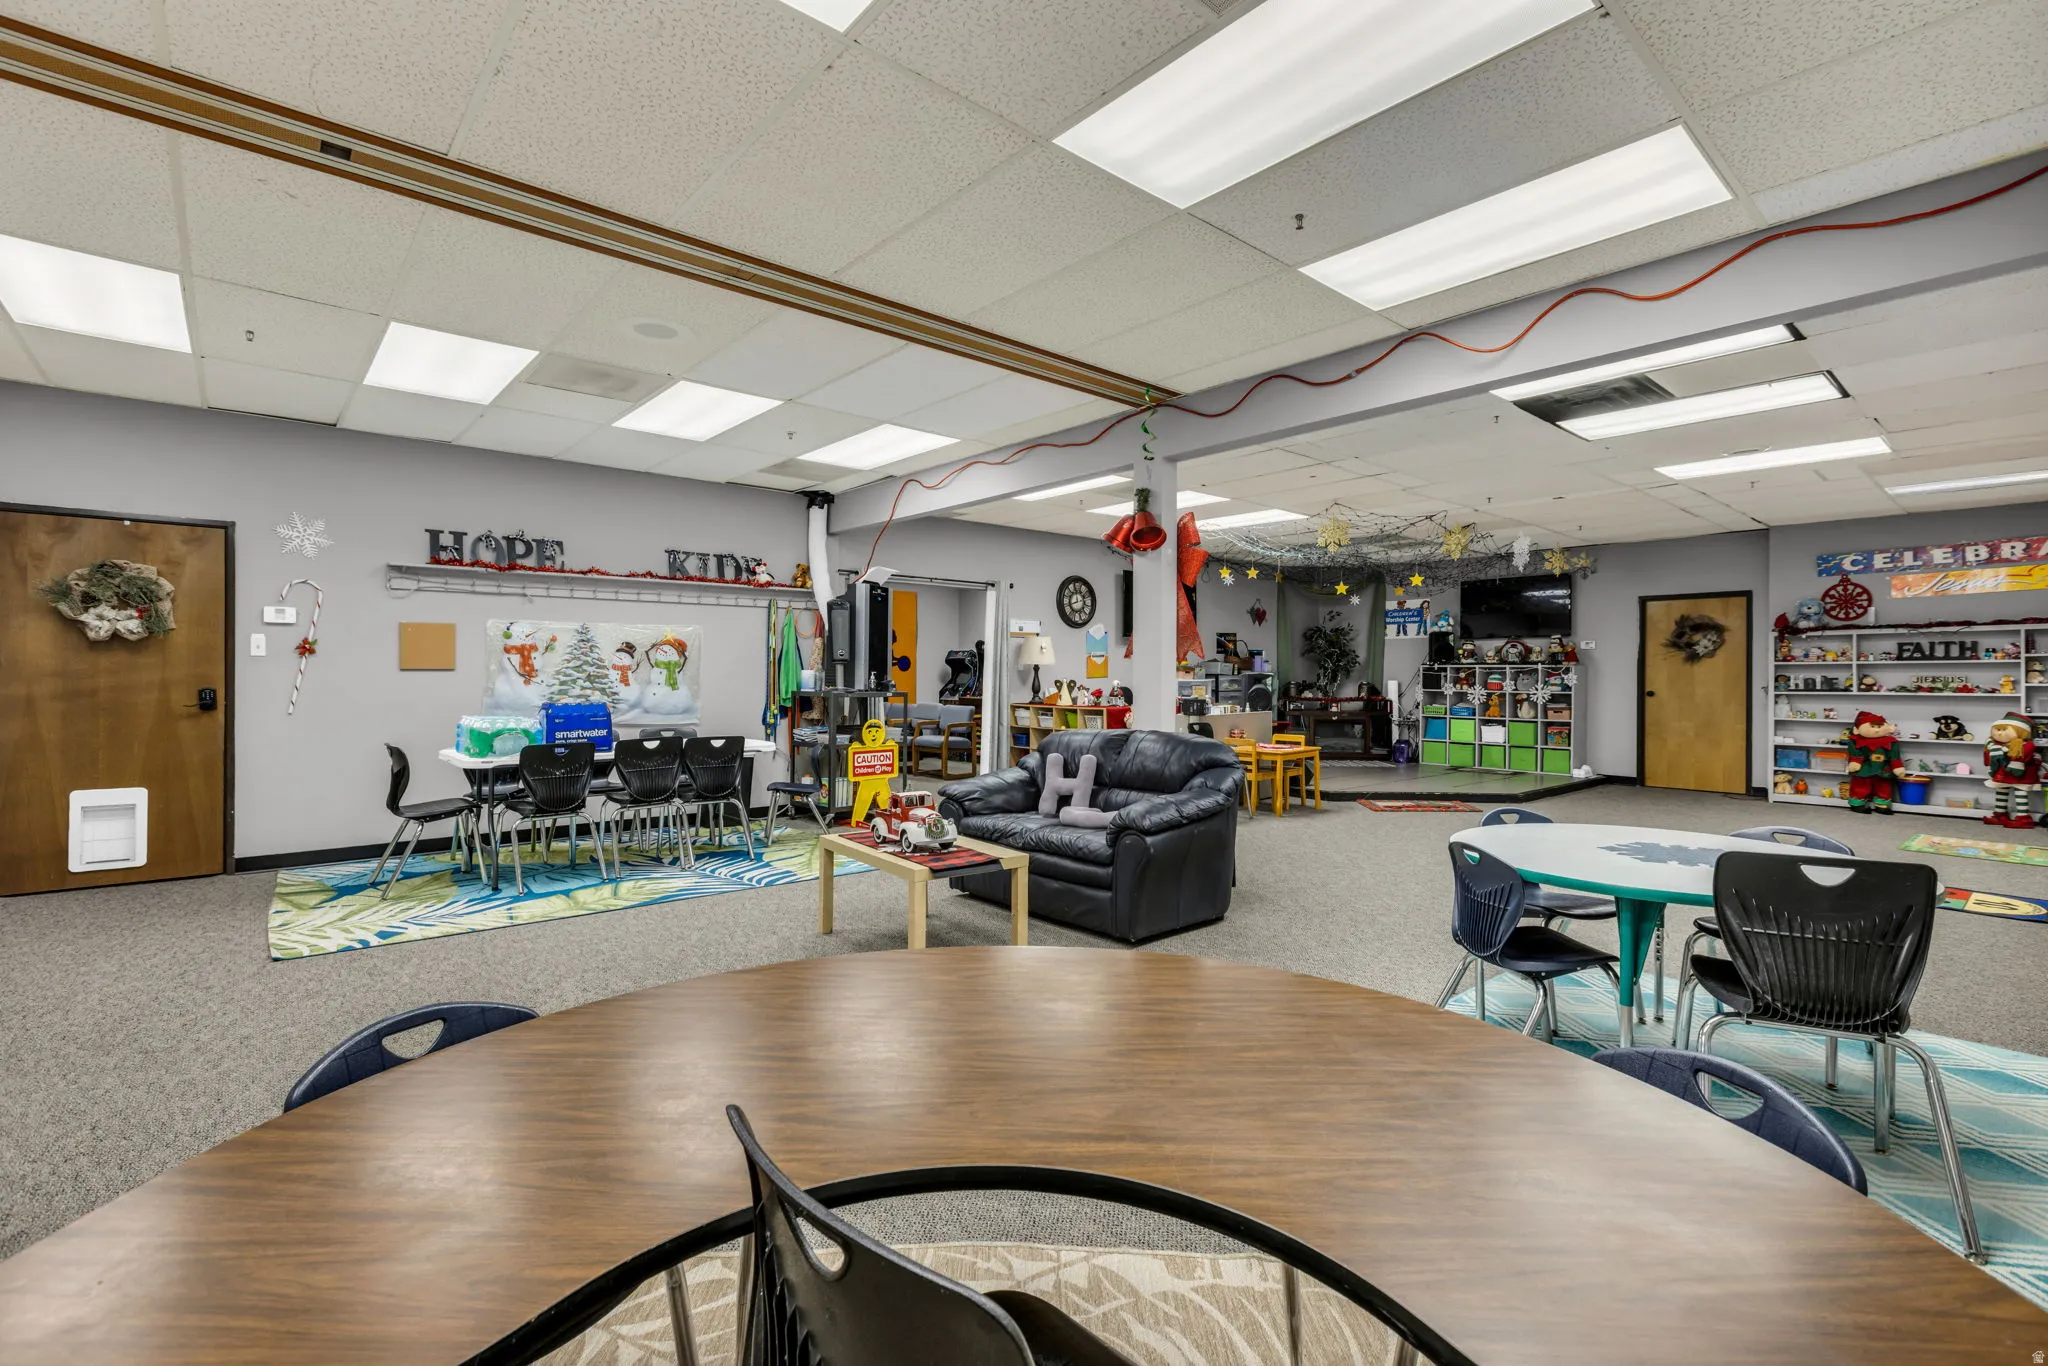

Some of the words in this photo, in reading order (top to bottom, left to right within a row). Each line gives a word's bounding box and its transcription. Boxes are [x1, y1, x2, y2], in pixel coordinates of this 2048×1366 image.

[425, 529, 564, 570] HOPE
[1904, 572, 2006, 595] Jesus
[1897, 641, 1978, 660] FAITH
[1912, 675, 1964, 684] JESUS
[555, 728, 608, 739] smartwater
[856, 753, 891, 765] CAUTION
[881, 765, 892, 773] Play
